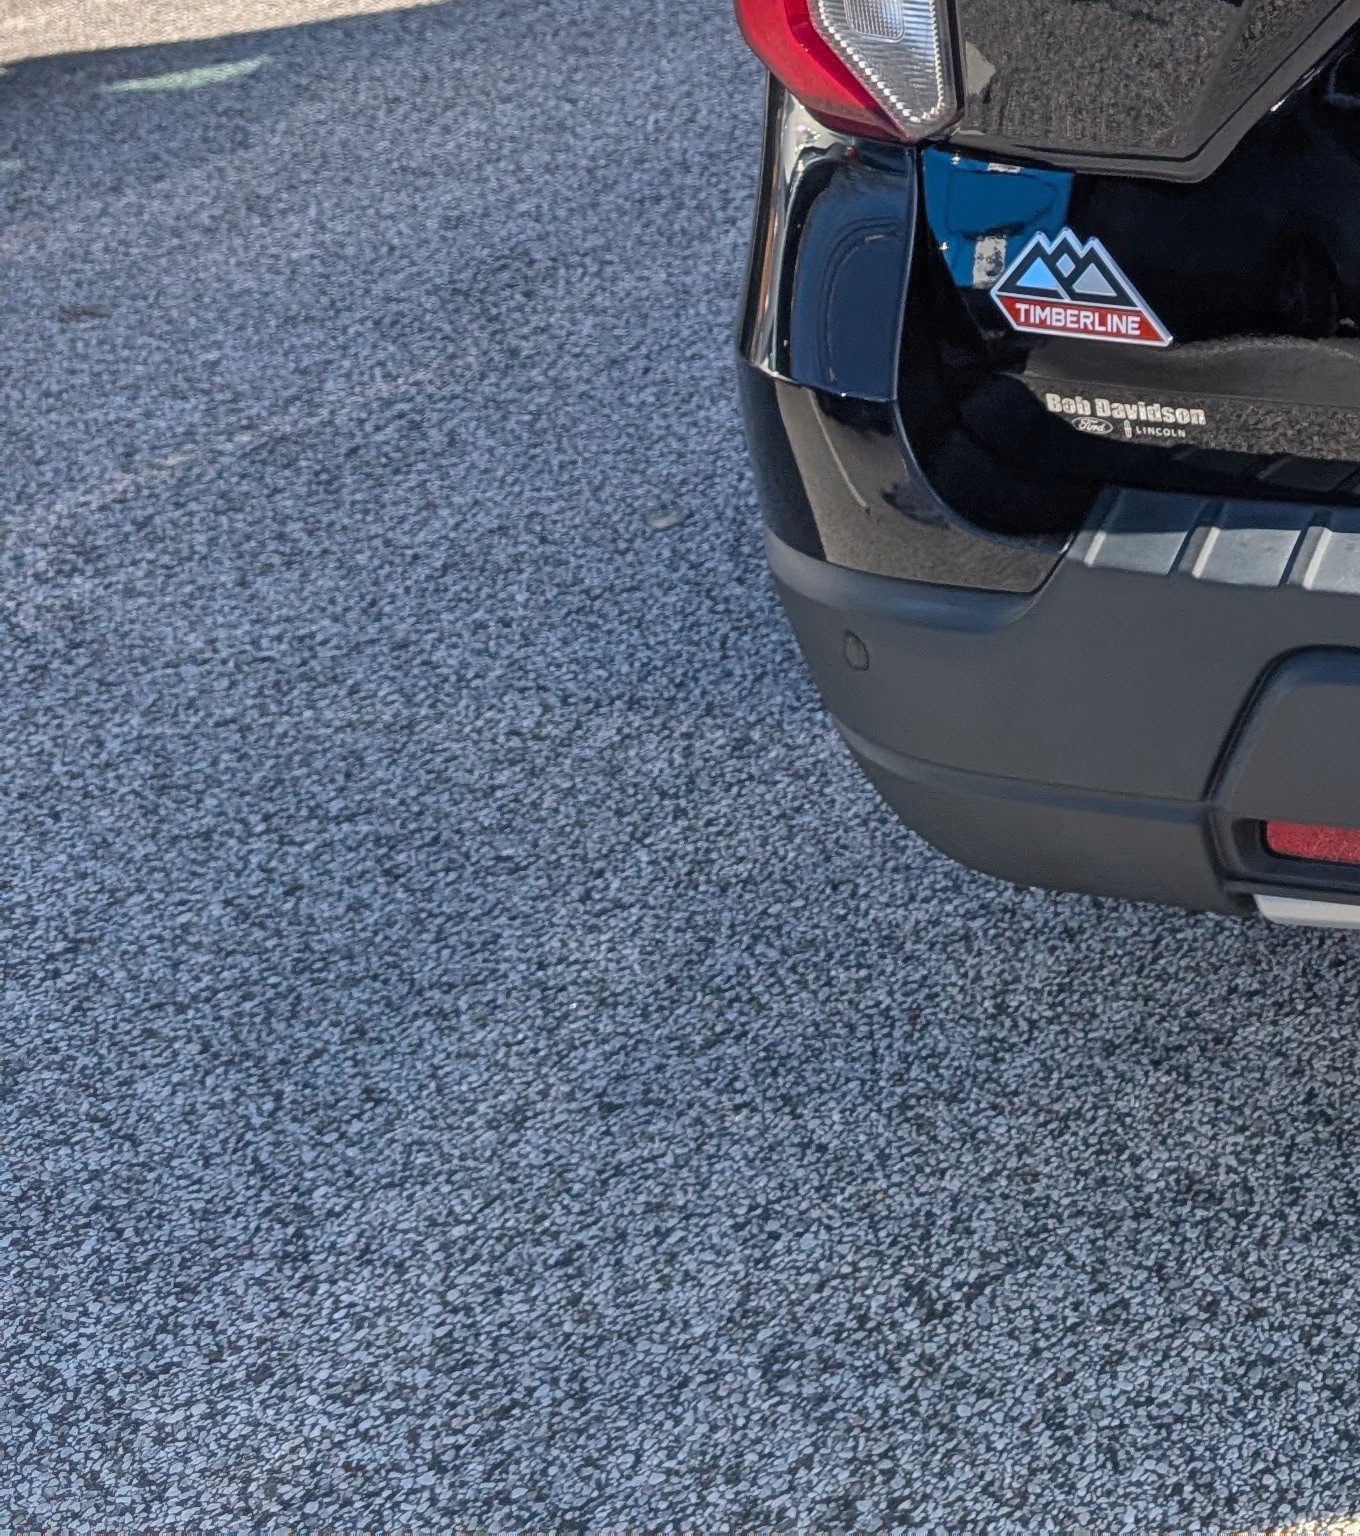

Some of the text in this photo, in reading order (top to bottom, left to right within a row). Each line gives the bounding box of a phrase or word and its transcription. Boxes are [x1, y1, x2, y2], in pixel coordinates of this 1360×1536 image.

[1015, 303, 1142, 335] TIMBERLINE
[1046, 392, 1207, 426] Bob Davidson
[1079, 418, 1187, 438] Ford LINCOLN
